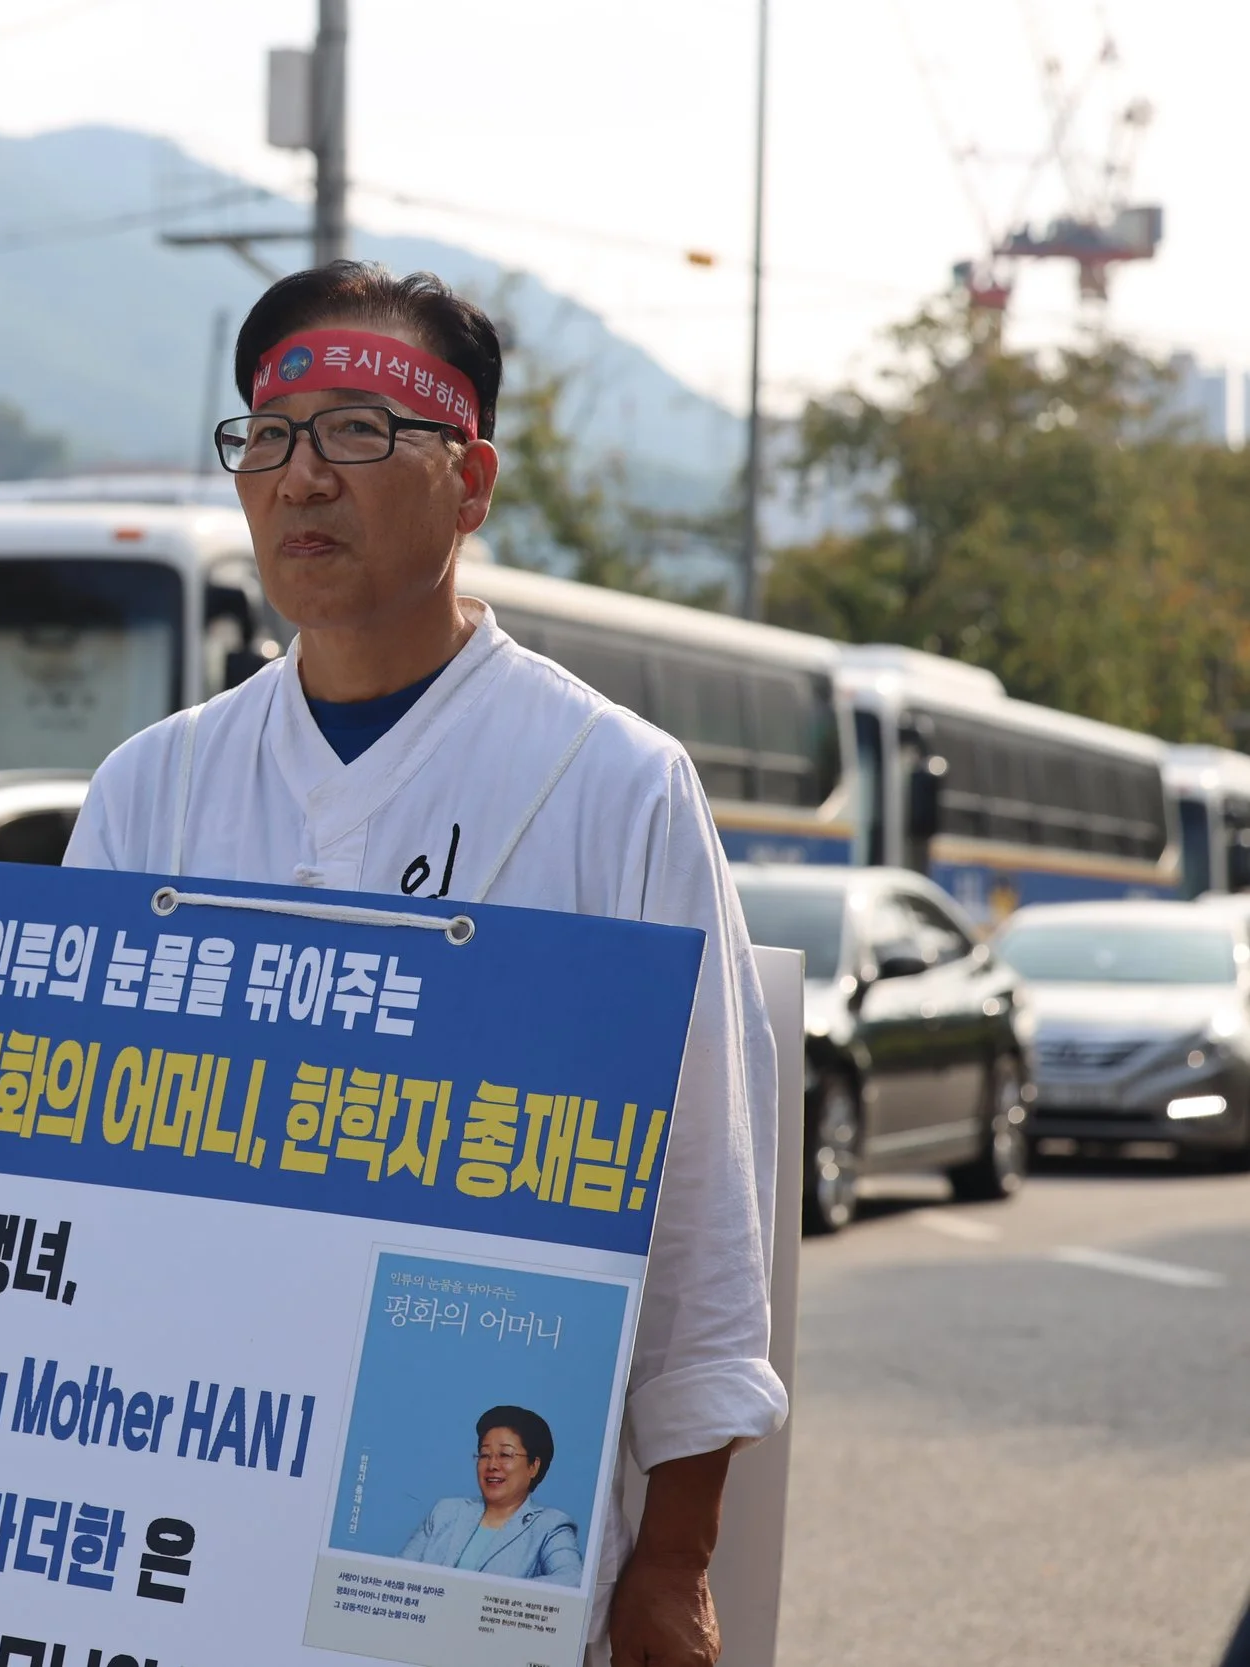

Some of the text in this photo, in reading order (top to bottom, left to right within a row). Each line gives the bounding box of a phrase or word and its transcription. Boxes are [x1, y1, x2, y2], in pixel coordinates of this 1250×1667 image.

[101, 931, 235, 1017] 눈물을
[244, 944, 422, 1037] 닦아주는
[103, 1047, 266, 1168] 어머니,
[280, 1063, 452, 1185] 한학자
[456, 1079, 667, 1213] 총재님!
[384, 1294, 563, 1350] 평화의 어머니
[390, 1272, 517, 1301] 인류의 눈물을 닦아주는
[10, 1356, 175, 1454] Mother
[136, 1517, 196, 1604] 은
[358, 1589, 381, 1601] 어머니
